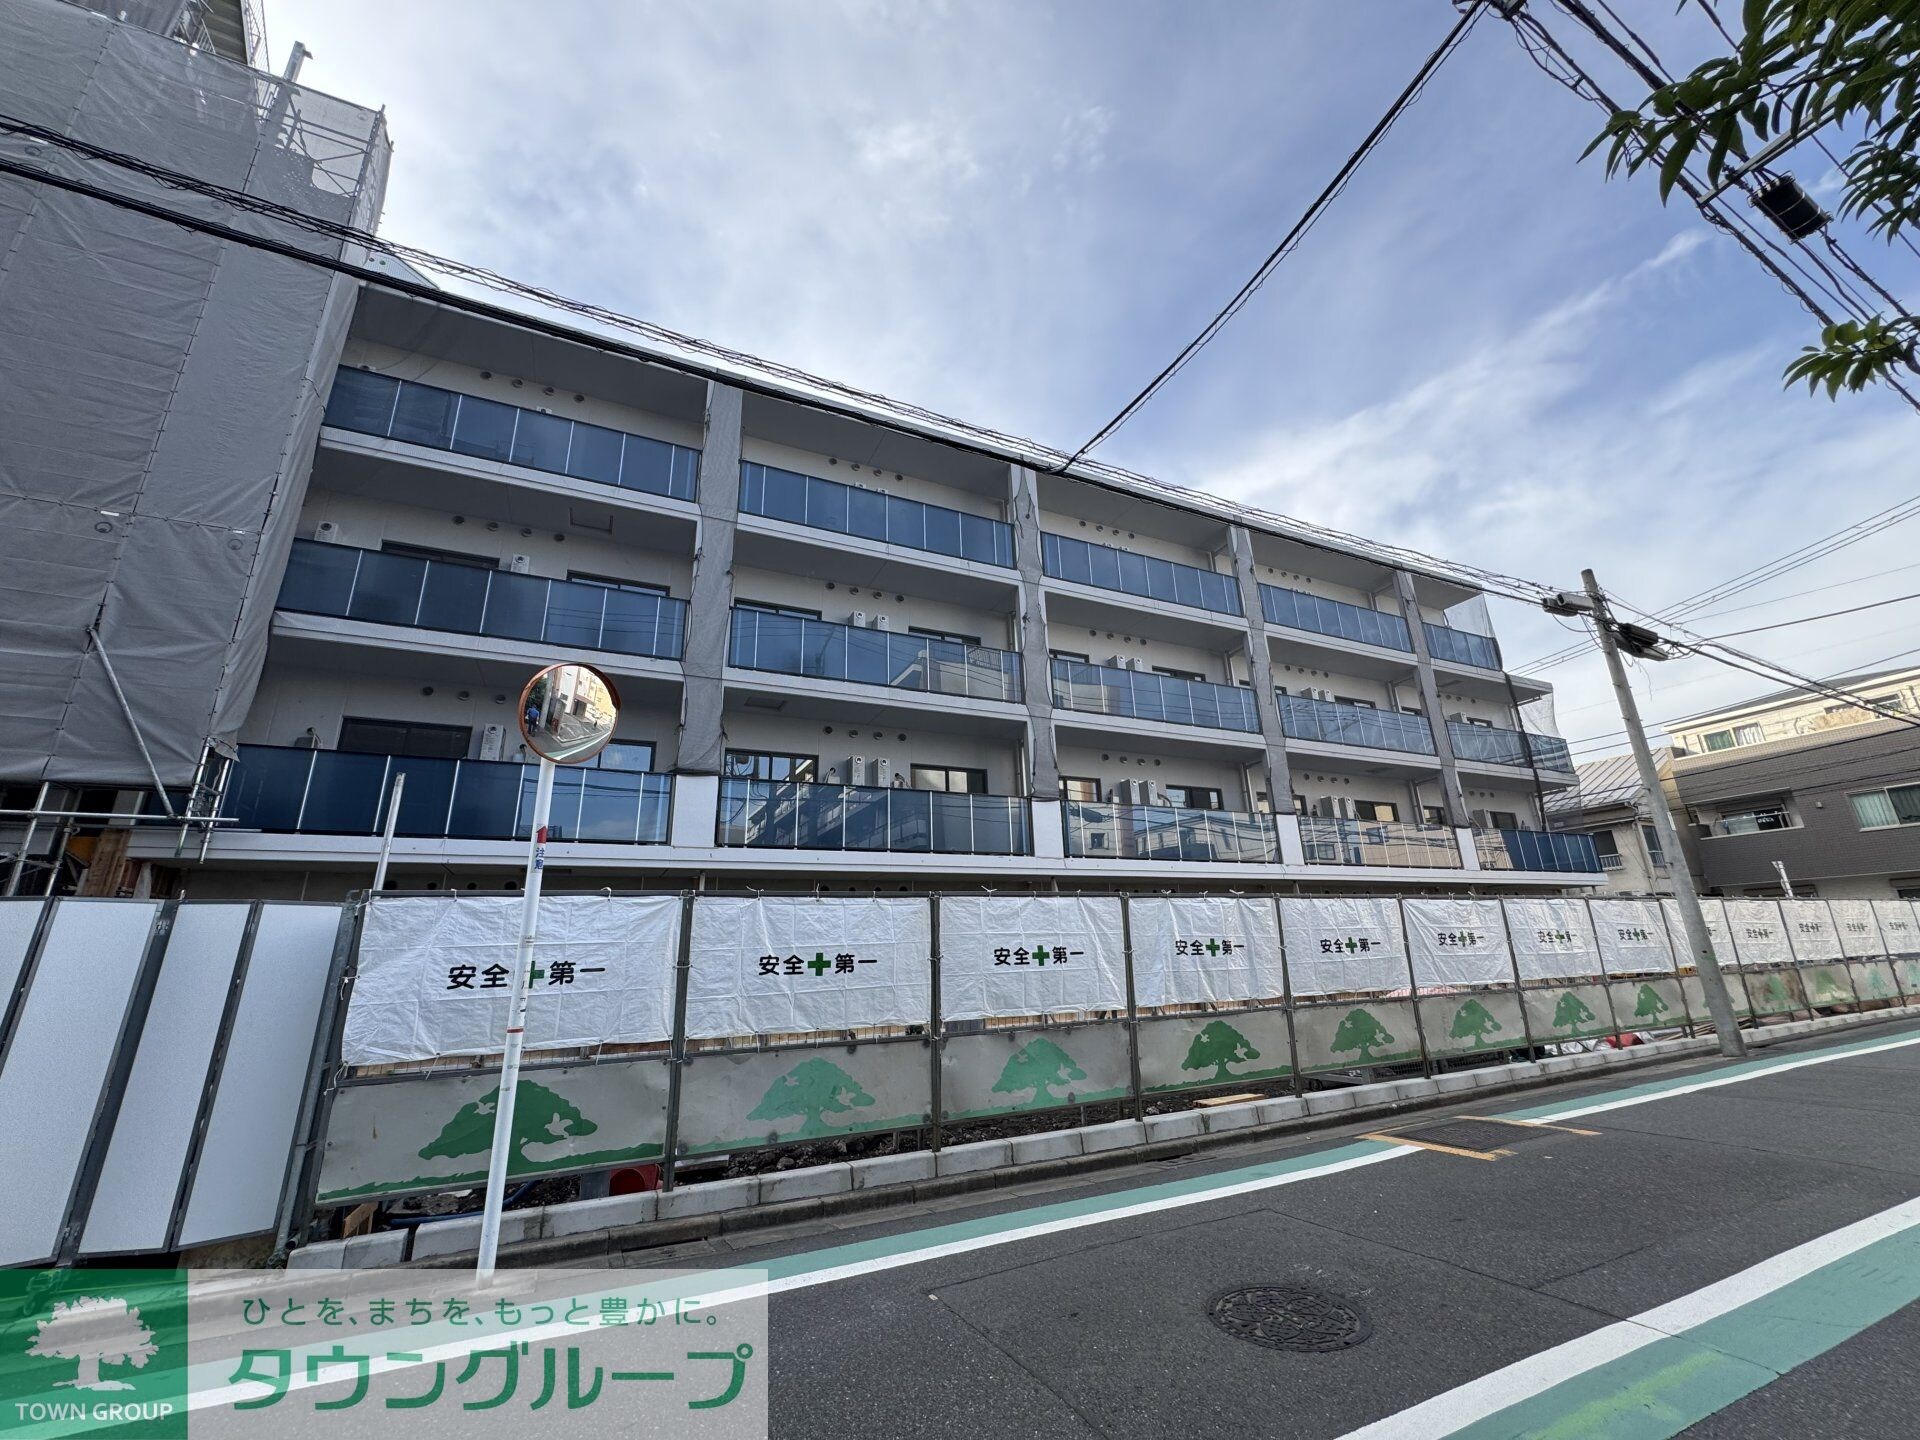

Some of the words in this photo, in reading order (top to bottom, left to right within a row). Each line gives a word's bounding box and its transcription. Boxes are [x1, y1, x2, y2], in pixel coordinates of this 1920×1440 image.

[758, 954, 804, 975] 安全
[994, 947, 1030, 966] 安全
[447, 964, 509, 989] 安全
